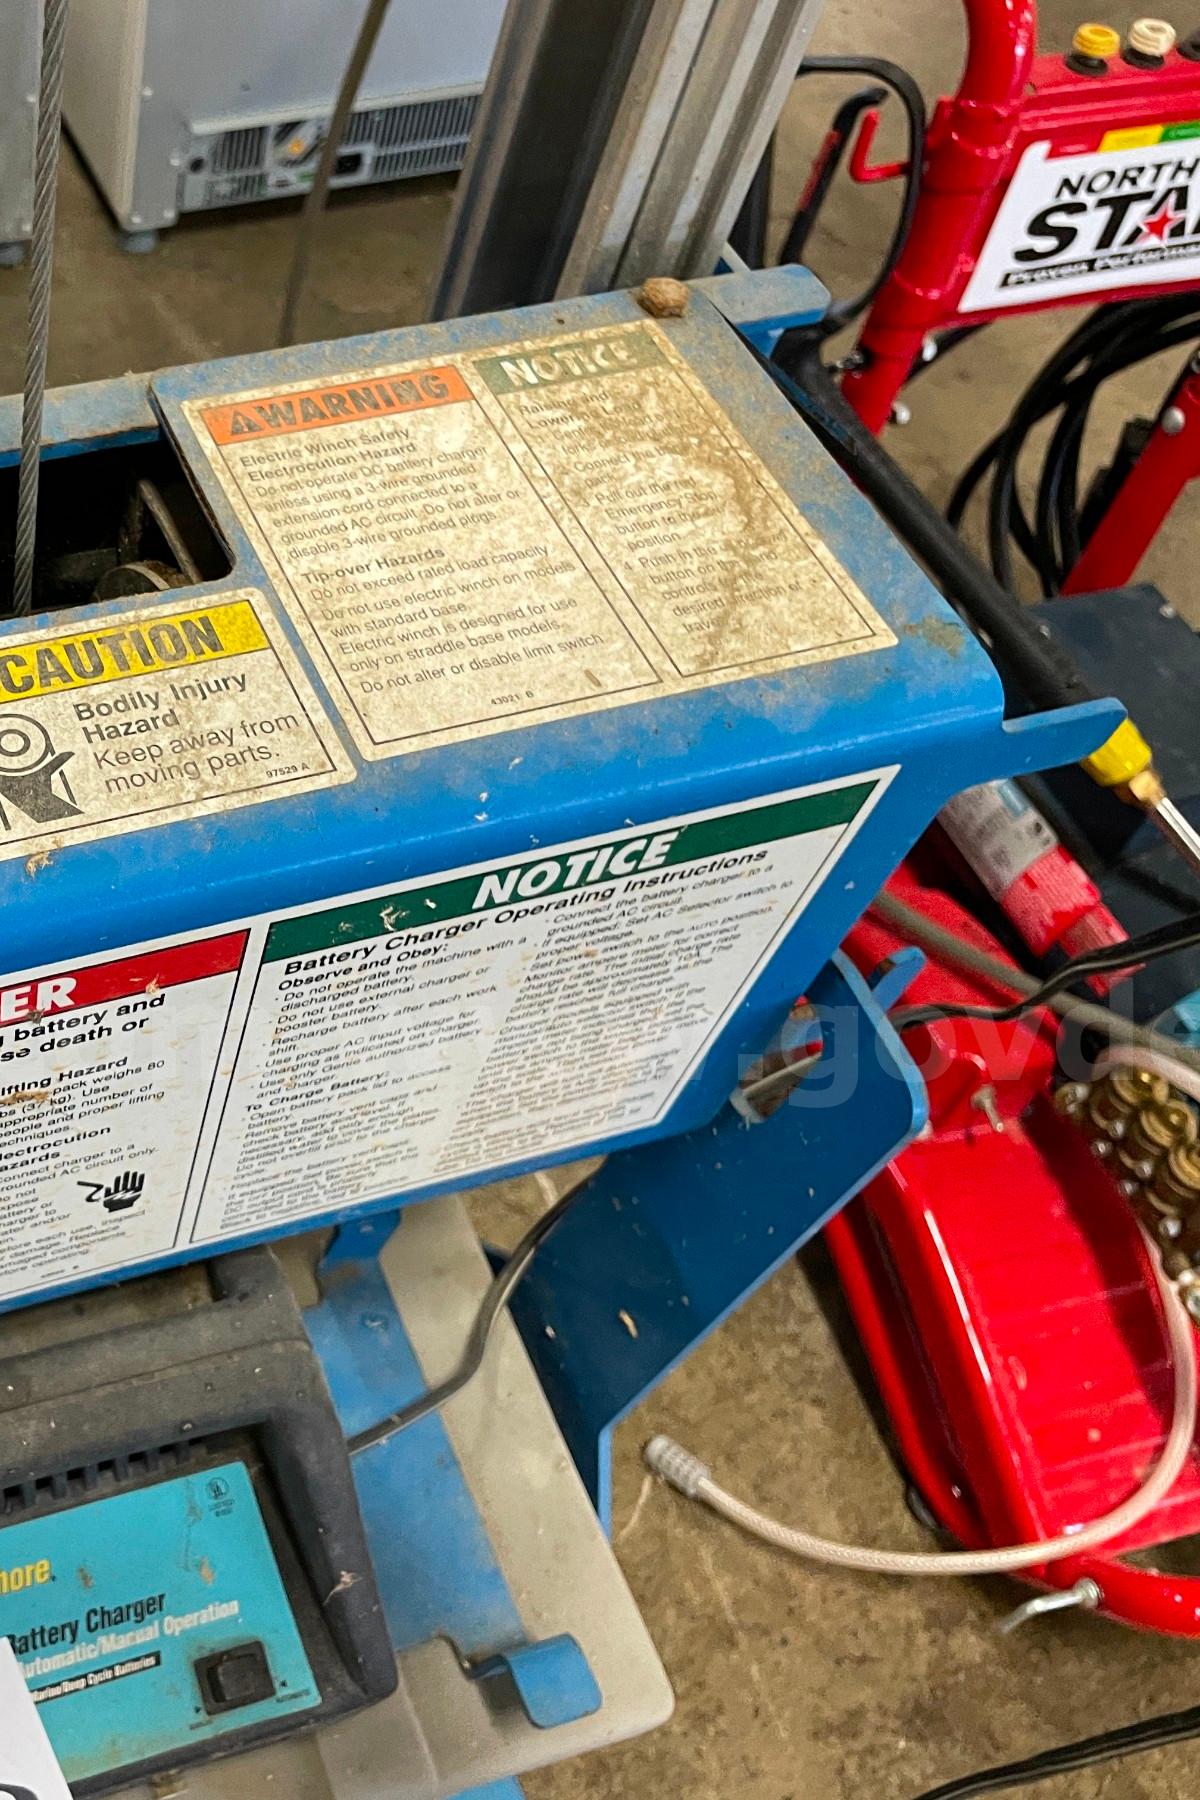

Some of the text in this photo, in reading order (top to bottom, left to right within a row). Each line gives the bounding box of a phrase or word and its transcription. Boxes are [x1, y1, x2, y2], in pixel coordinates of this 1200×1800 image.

[1056, 157, 1200, 198] NORTH
[1014, 185, 1200, 261] STA
[501, 341, 637, 386] NOTICE
[255, 375, 448, 428] WARNING
[239, 427, 409, 468] Electric Winch Safety
[247, 441, 417, 482] Electrocution Hazard
[300, 548, 445, 584] Tip-over Hazards
[309, 586, 333, 604] Do
[335, 581, 361, 596] not
[361, 569, 415, 591] exceed
[417, 561, 456, 581] rated
[454, 554, 489, 571] load
[320, 560, 576, 621] Do not use electric winch on models
[329, 622, 362, 638] with
[363, 607, 429, 632] standard
[338, 597, 578, 655] Electric winch is designed for use
[348, 656, 380, 672] only
[383, 652, 404, 665] on
[405, 639, 466, 660] straddle
[464, 631, 505, 647] base
[359, 680, 384, 694] Do
[385, 673, 412, 688] not
[414, 667, 446, 683] alter
[449, 663, 465, 675] or
[468, 651, 522, 671] disable
[522, 643, 555, 659] limit
[72, 673, 246, 721] Bodily Injury
[82, 709, 180, 744] Hazard
[93, 714, 299, 770] Keep away from
[104, 745, 280, 793] moving parts.
[265, 761, 311, 778] 97529 A
[473, 832, 677, 908] NOTICE
[284, 850, 767, 975] Battery Charger Operating Instructions
[278, 943, 448, 991] Observe and Obey:
[283, 936, 527, 1002] Do not operate the machine with a
[14, 1009, 107, 1042] battery
[116, 993, 166, 1016] and
[39, 1025, 112, 1053] death
[121, 1017, 149, 1032] or
[52, 1059, 165, 1097] pack weighs 80
[58, 1056, 128, 1082] Hazard
[47, 1112, 74, 1126] and
[77, 1101, 124, 1120] proper
[128, 1090, 165, 1105] lifting
[80, 1088, 134, 1107] number
[138, 1082, 153, 1093] of
[86, 1592, 166, 1633] Charger
[163, 1600, 239, 1635] Operation
